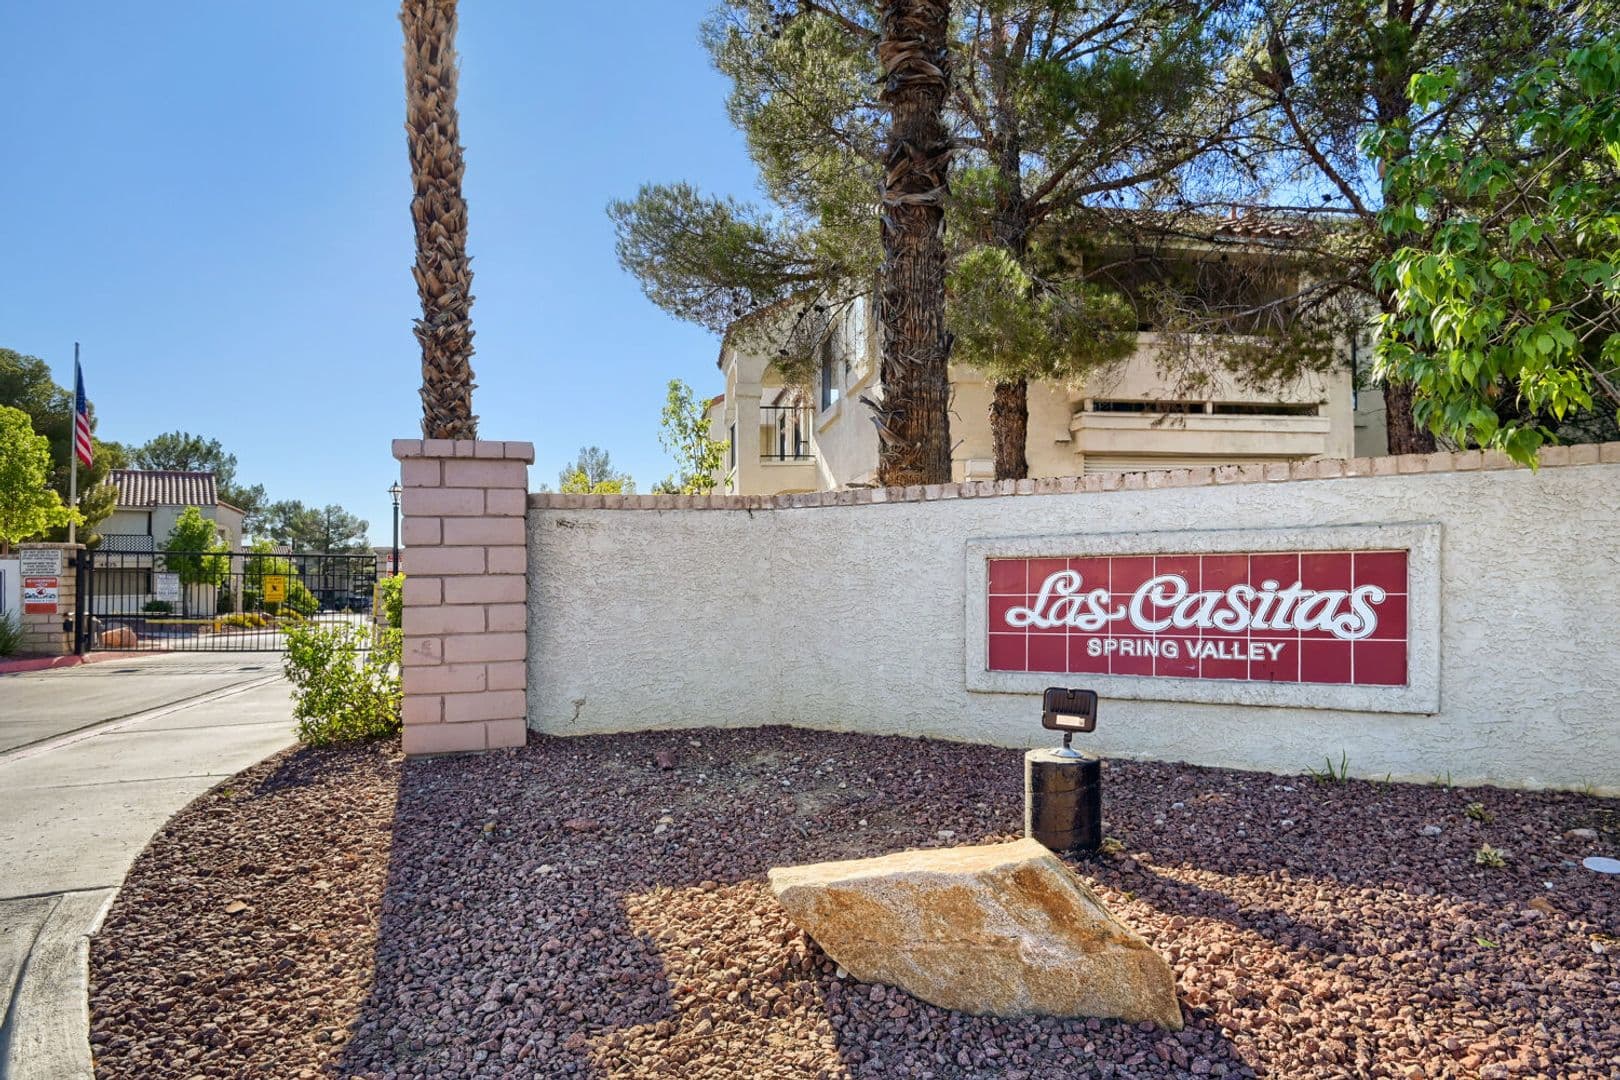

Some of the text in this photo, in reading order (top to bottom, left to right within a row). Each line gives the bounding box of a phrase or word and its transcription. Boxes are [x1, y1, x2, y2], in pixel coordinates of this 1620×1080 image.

[1005, 569, 1386, 640] Las Casitas
[1086, 637, 1286, 661] SPRING VALLEY
